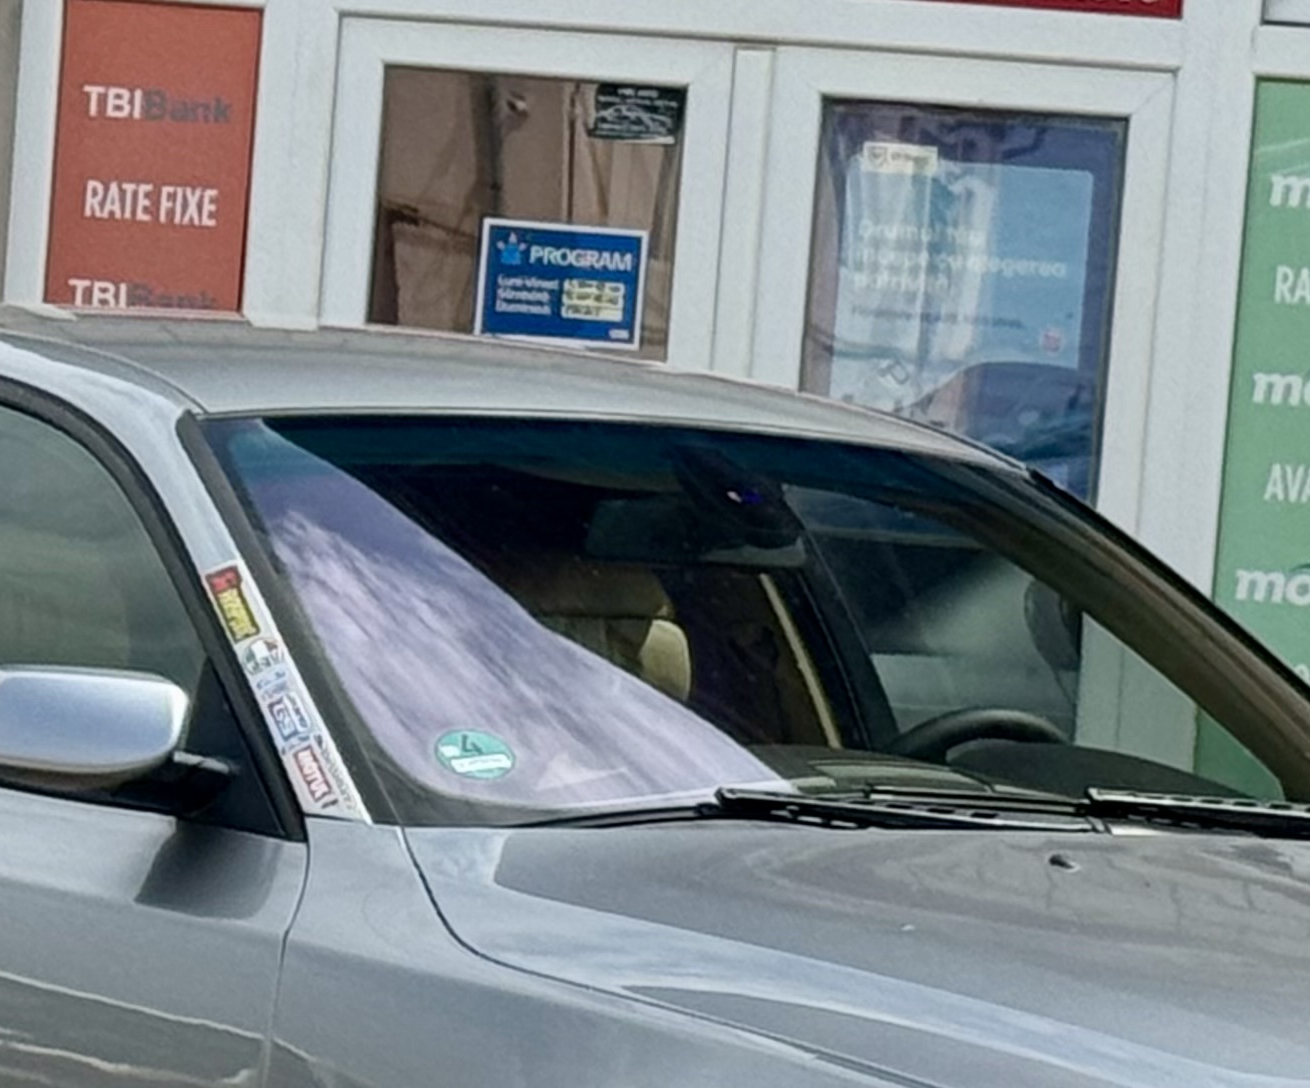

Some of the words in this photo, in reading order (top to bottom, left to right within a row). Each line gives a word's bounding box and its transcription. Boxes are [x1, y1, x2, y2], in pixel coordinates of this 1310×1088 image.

[84, 178, 154, 222] RATE
[159, 184, 219, 227] FIXE
[528, 244, 633, 272] PROGRAM
